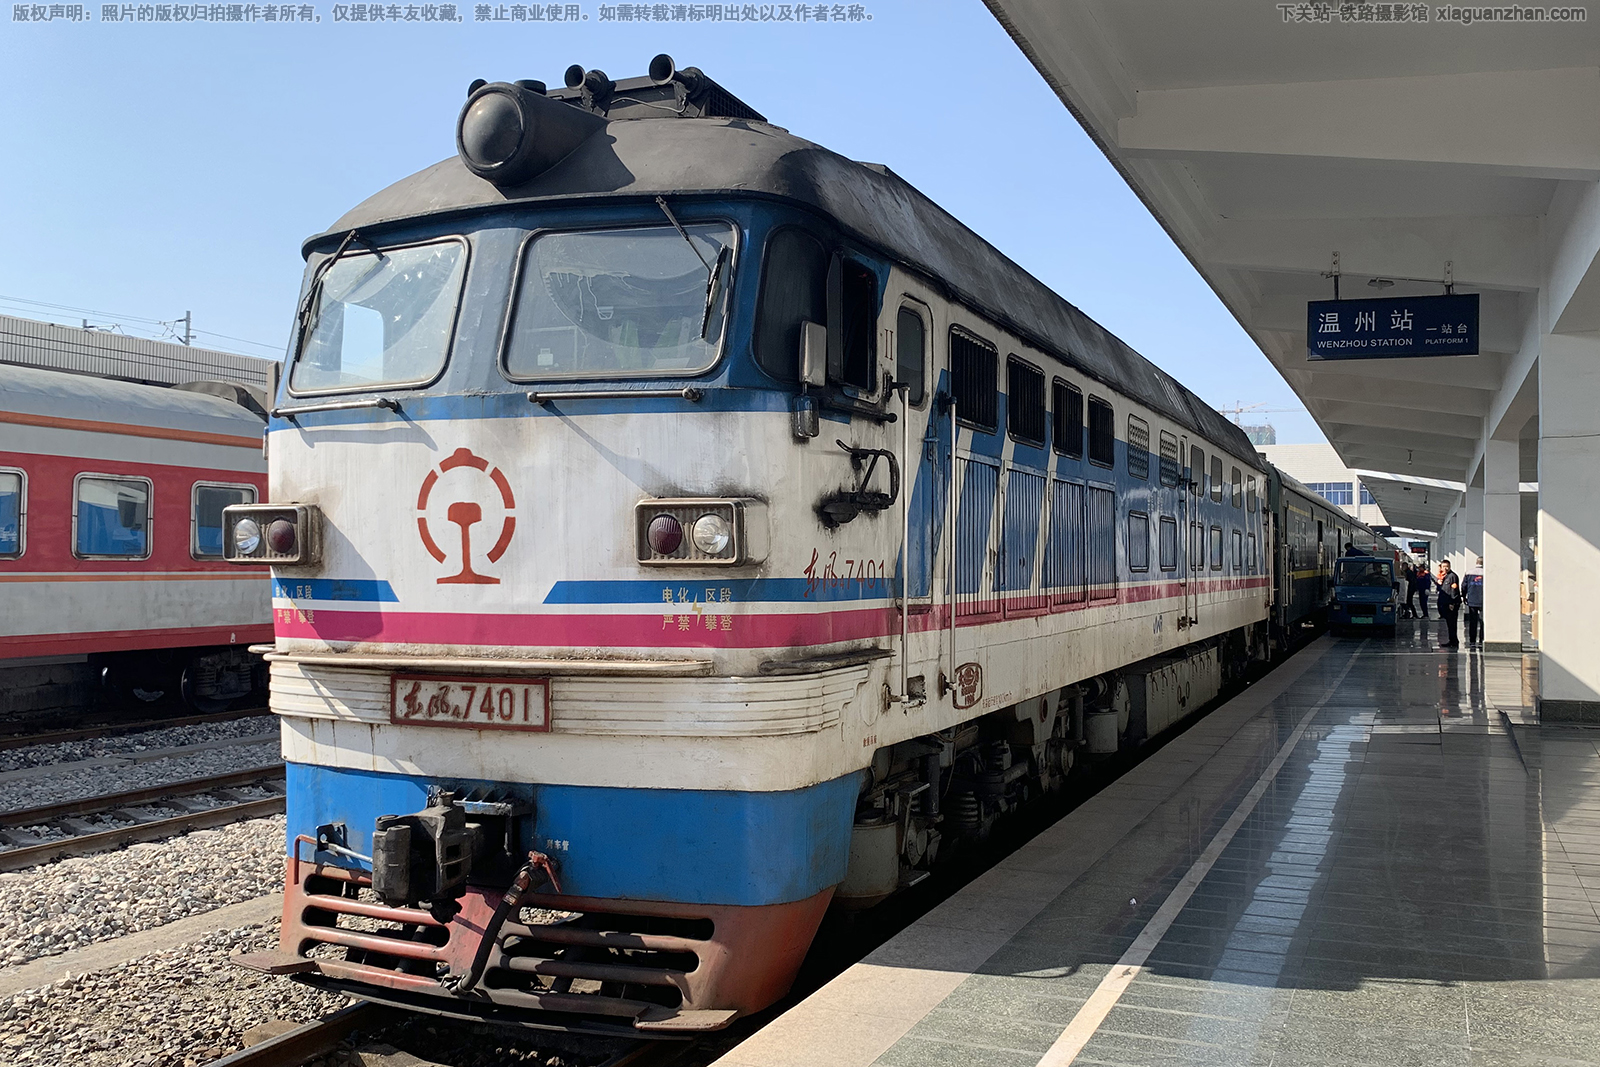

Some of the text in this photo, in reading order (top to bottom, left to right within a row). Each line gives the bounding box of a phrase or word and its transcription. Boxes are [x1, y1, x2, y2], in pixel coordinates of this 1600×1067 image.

[1318, 309, 1414, 333] 温州站
[1426, 323, 1468, 334] 一站台
[1317, 338, 1413, 349] WENZHOU STATION
